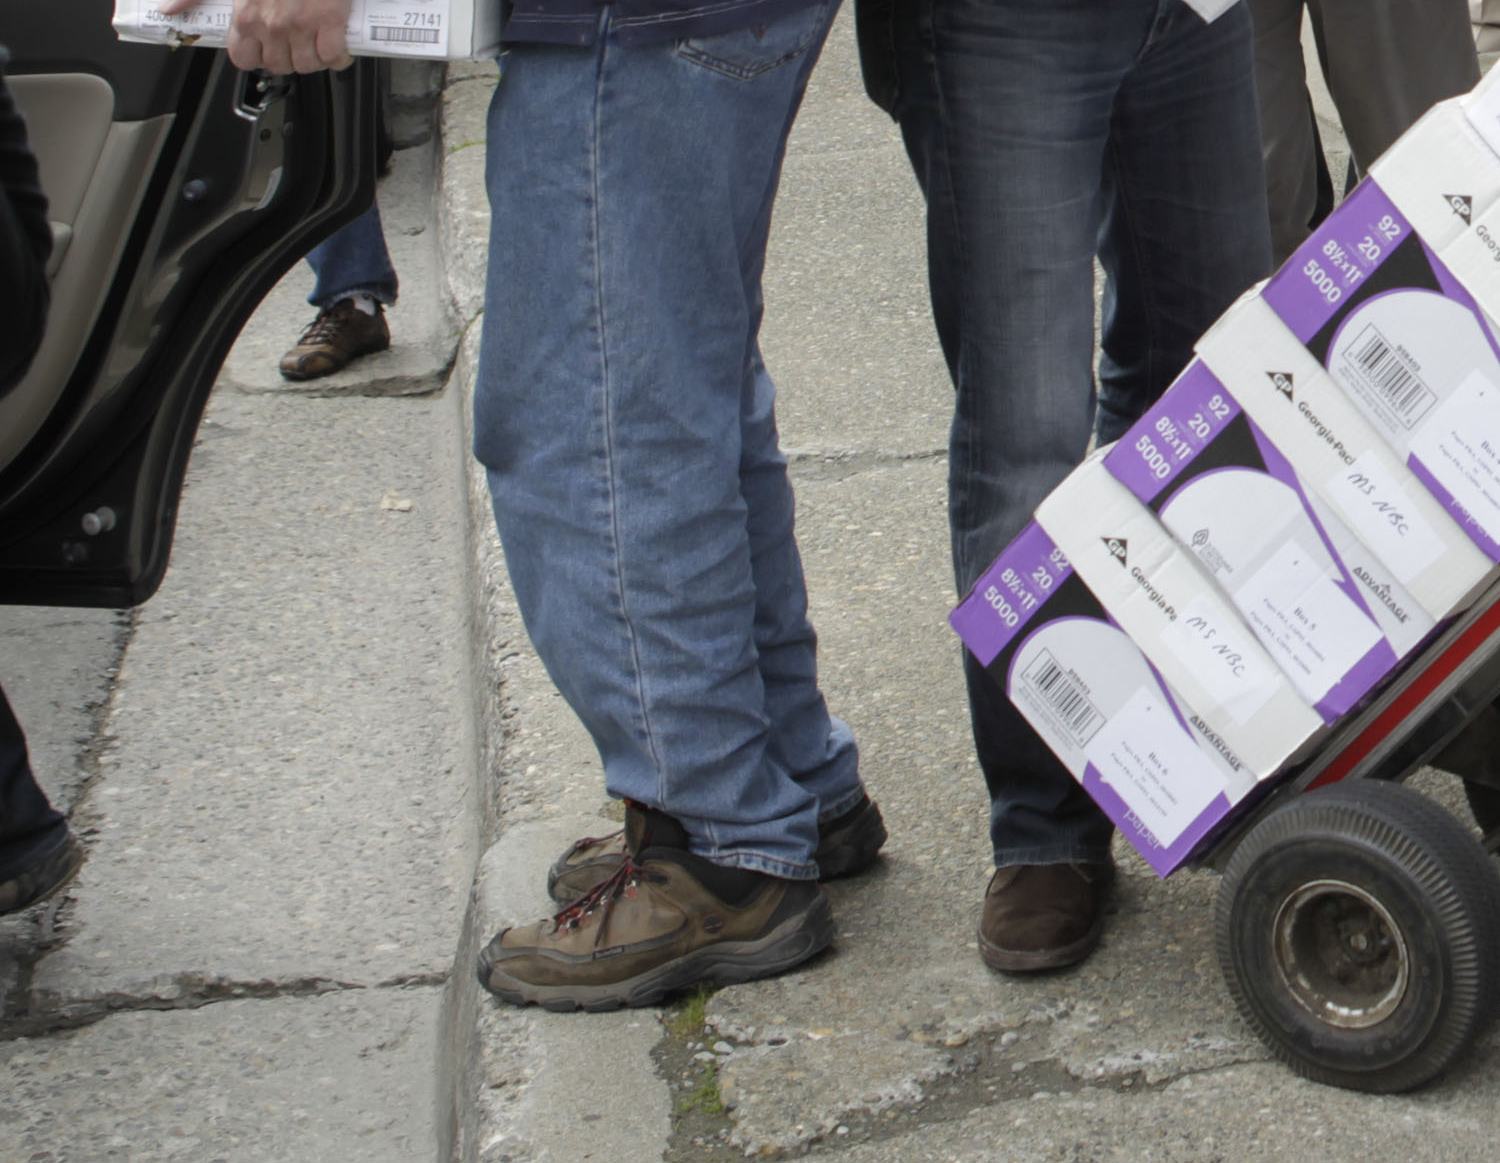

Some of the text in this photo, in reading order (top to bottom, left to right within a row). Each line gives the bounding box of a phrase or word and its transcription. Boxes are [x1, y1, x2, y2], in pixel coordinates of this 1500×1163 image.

[403, 12, 442, 27] 27141
[1451, 196, 1472, 216] GP
[1378, 215, 1401, 241] 92
[1357, 236, 1381, 261] 20
[1303, 259, 1342, 303] 5000
[1273, 373, 1292, 392] GP
[1208, 394, 1230, 421] 92
[1188, 413, 1211, 438] 20
[1135, 435, 1171, 479] 5000
[1481, 440, 1496, 458] Box
[1050, 547, 1069, 572] 92
[1107, 538, 1126, 558] GP
[1032, 566, 1053, 589] 20
[984, 585, 1019, 627] 5000
[1352, 566, 1409, 624] ADVANTAGE
[1293, 606, 1308, 625] Box
[1189, 714, 1242, 773] ADVANTAGE
[1148, 751, 1162, 770] Box
